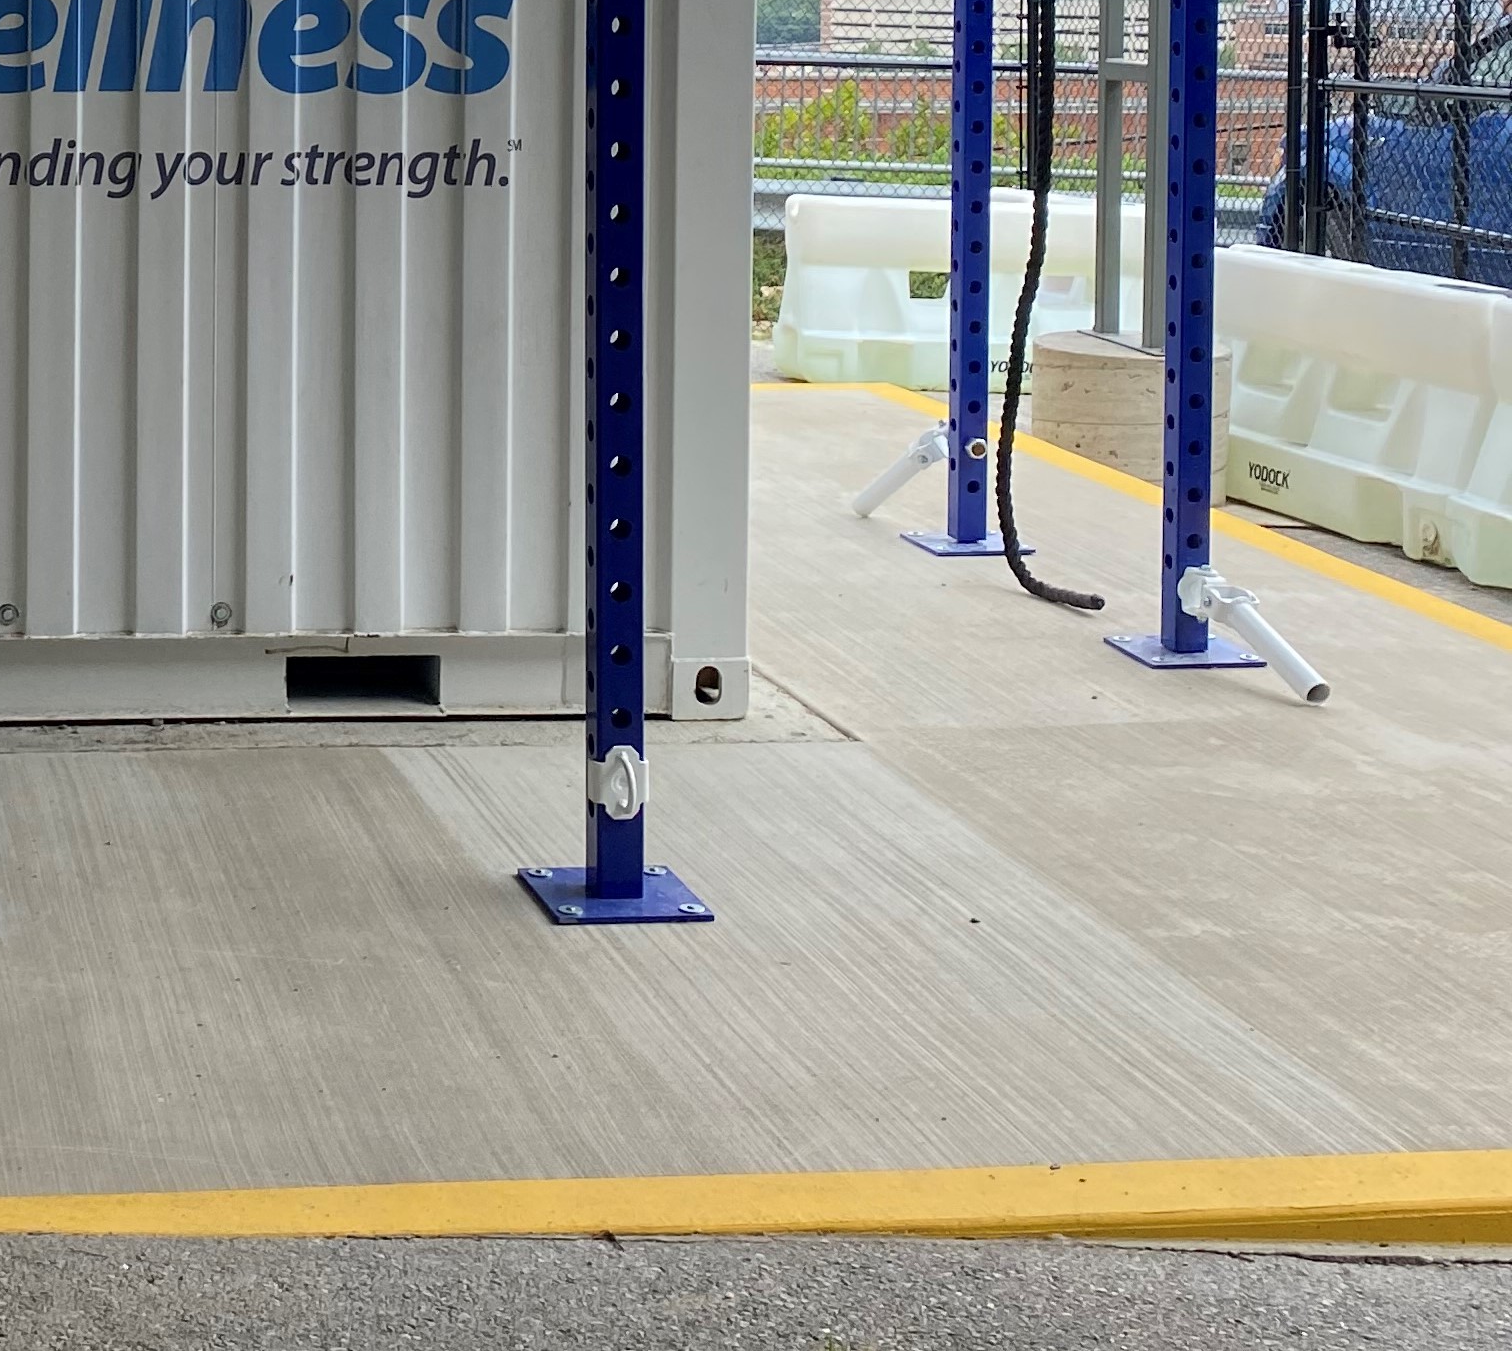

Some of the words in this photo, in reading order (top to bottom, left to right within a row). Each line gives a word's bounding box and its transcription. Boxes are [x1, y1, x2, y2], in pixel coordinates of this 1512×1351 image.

[150, 151, 273, 200] your
[280, 138, 509, 199] strength.
[1248, 460, 1291, 490] YODOCK
